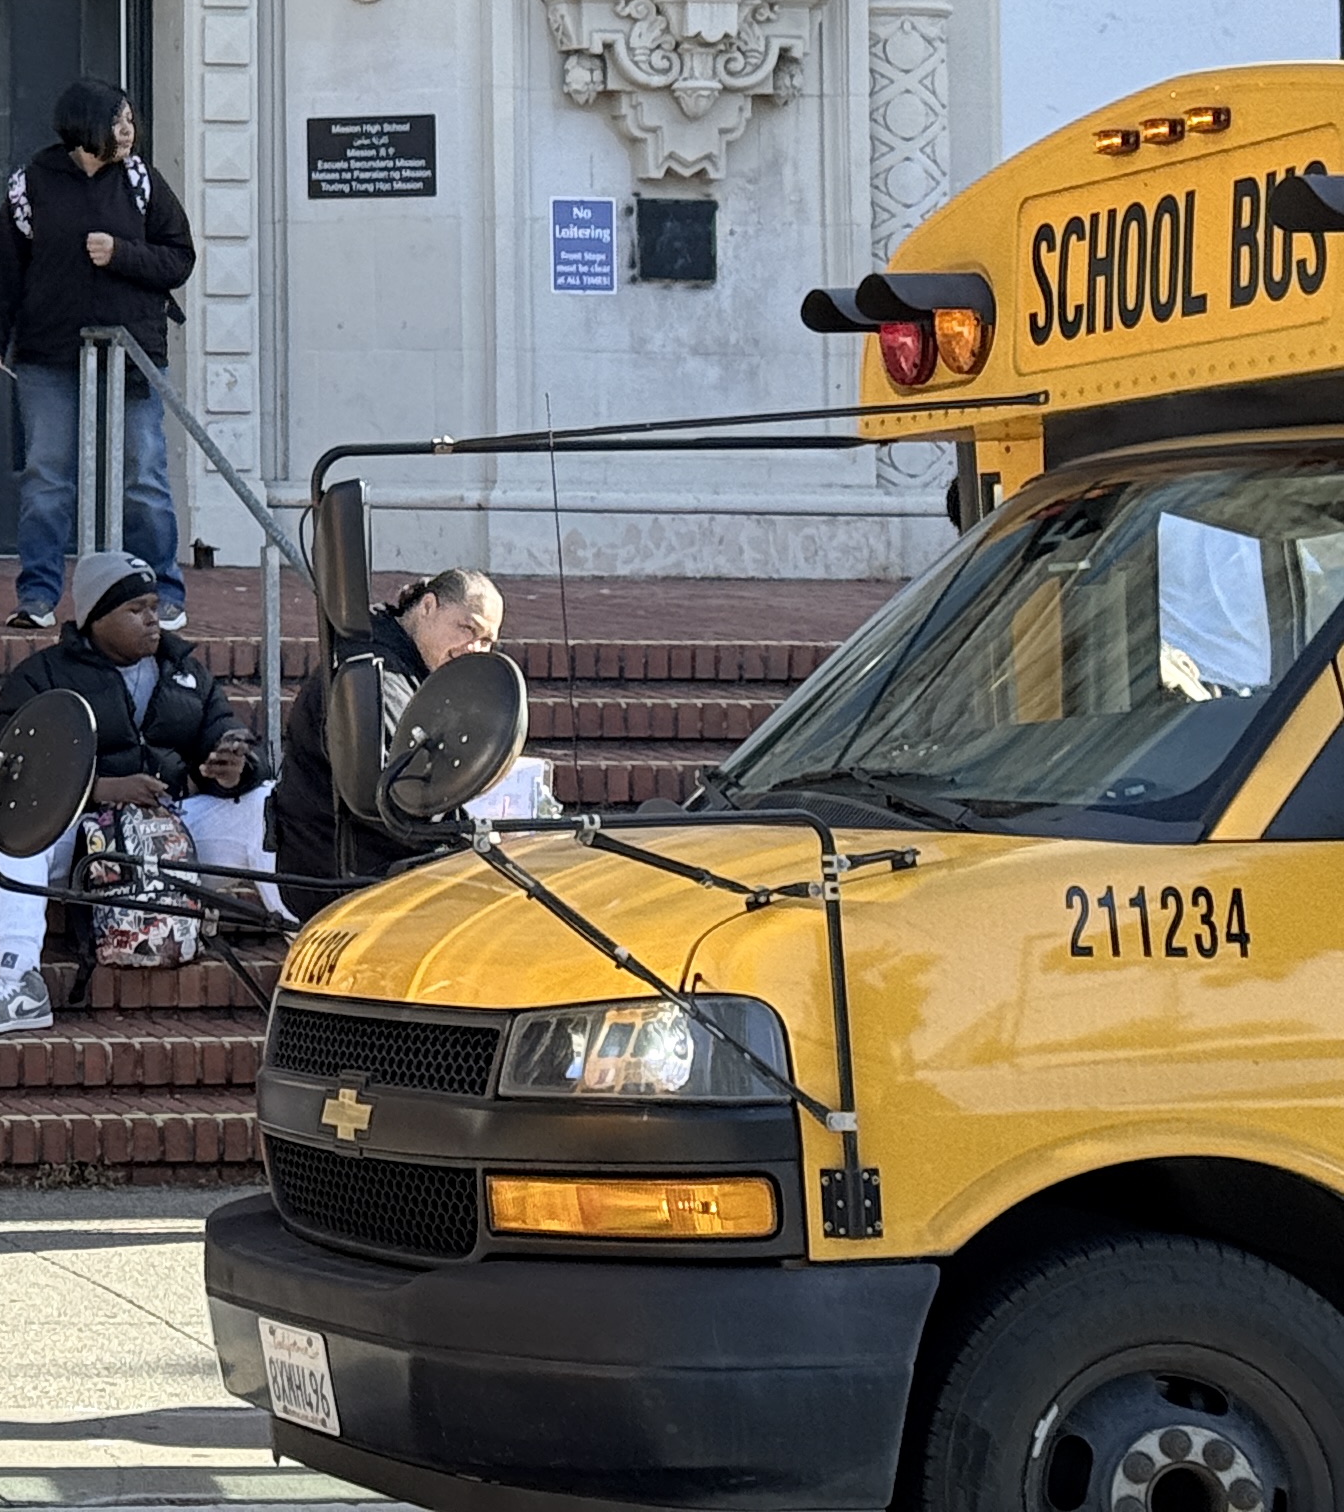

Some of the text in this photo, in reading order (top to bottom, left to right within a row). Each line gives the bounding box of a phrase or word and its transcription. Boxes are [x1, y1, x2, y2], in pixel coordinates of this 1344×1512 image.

[555, 224, 611, 243] Loitering
[572, 205, 592, 219] No
[1029, 189, 1207, 346] SCHOOL
[1065, 885, 1250, 959] 211234
